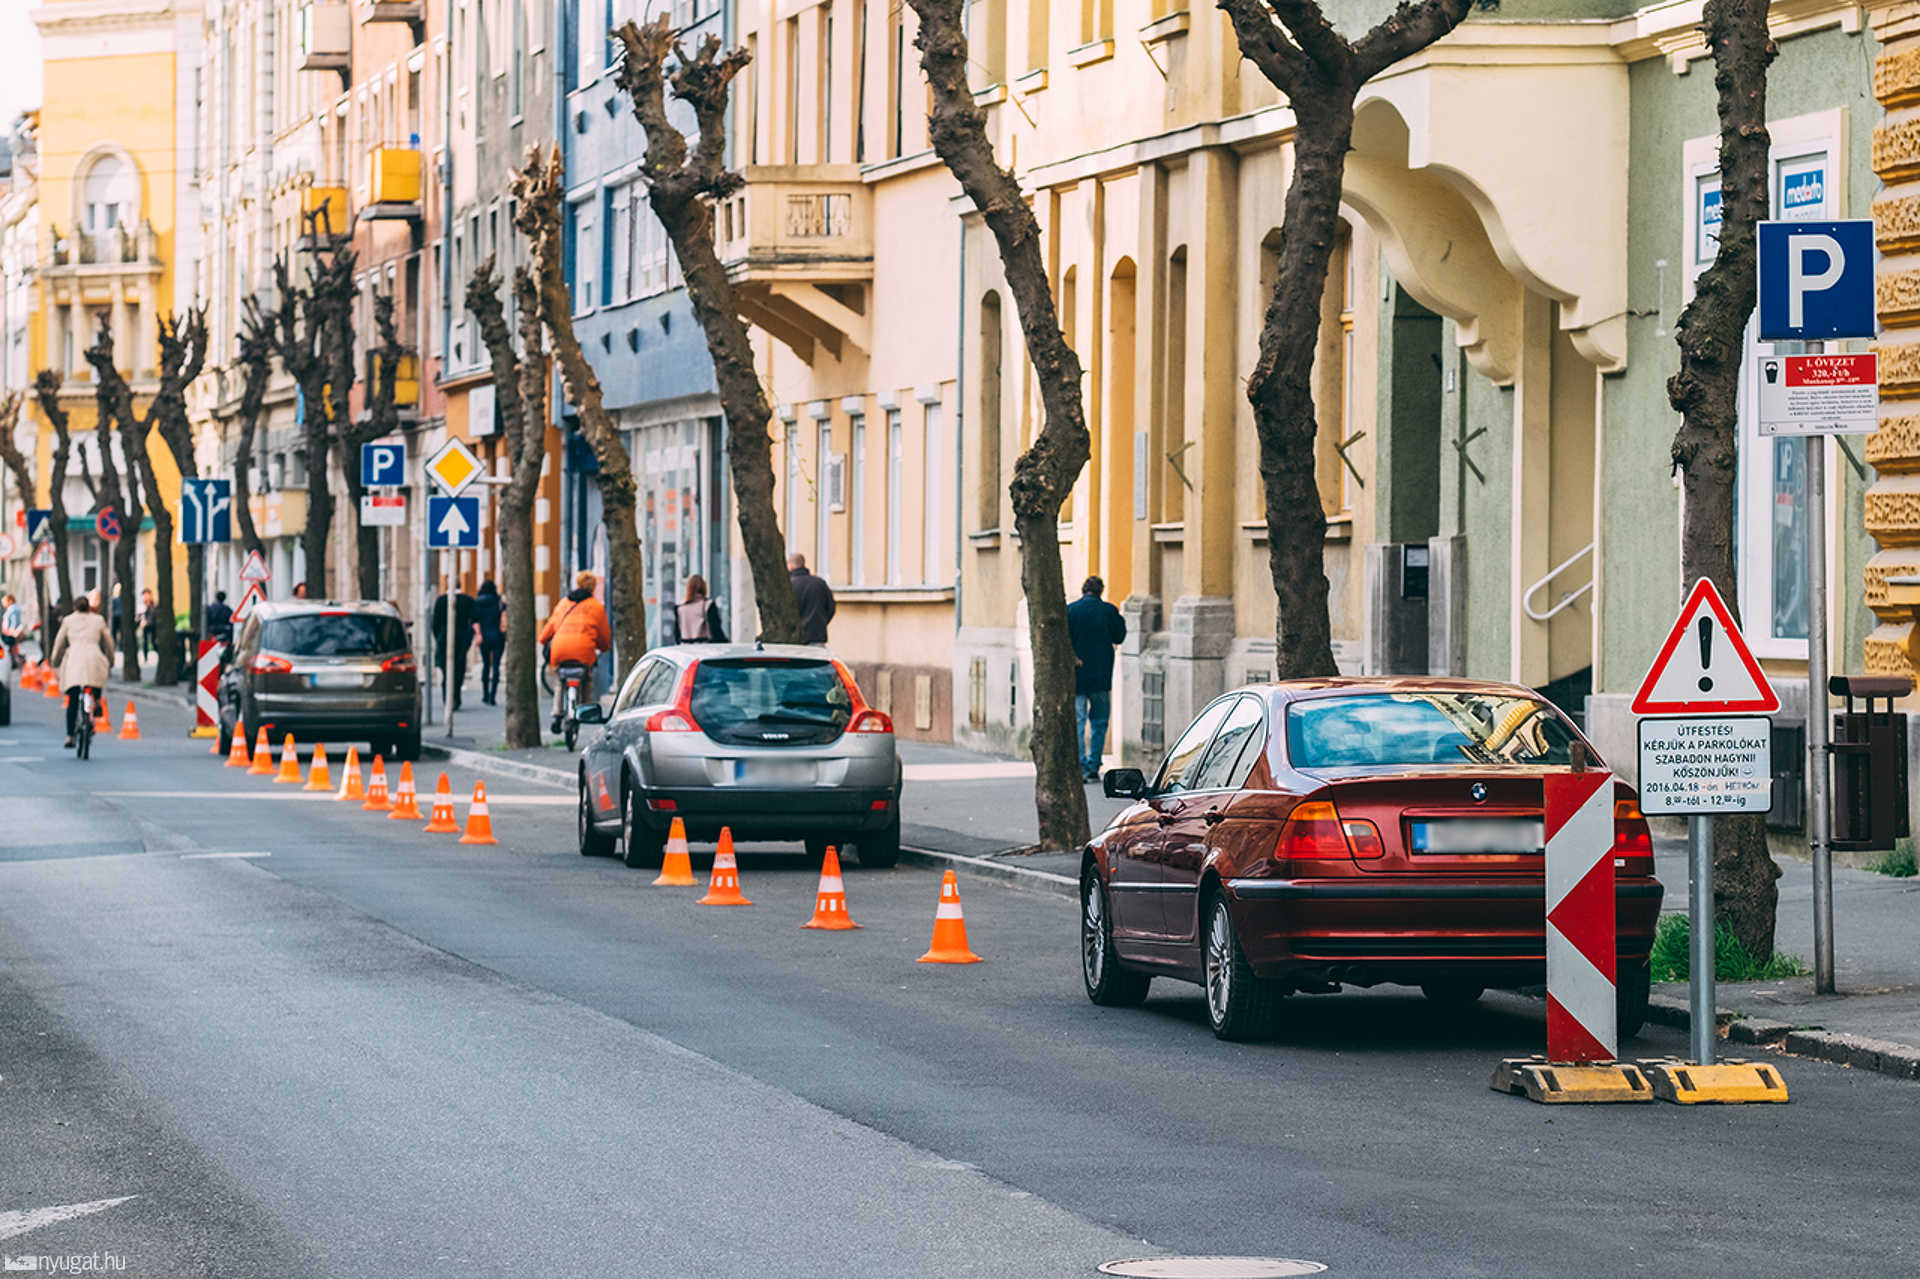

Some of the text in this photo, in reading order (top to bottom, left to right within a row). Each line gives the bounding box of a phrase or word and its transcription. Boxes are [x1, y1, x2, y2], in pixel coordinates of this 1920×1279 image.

[1788, 234, 1845, 328] P
[373, 448, 394, 482] P
[1677, 724, 1734, 737] ÚTFESTÉS!
[1688, 740, 1695, 750] A
[1697, 736, 1767, 750] PARKOLÓKAT
[1655, 753, 1712, 765] SZABADON
